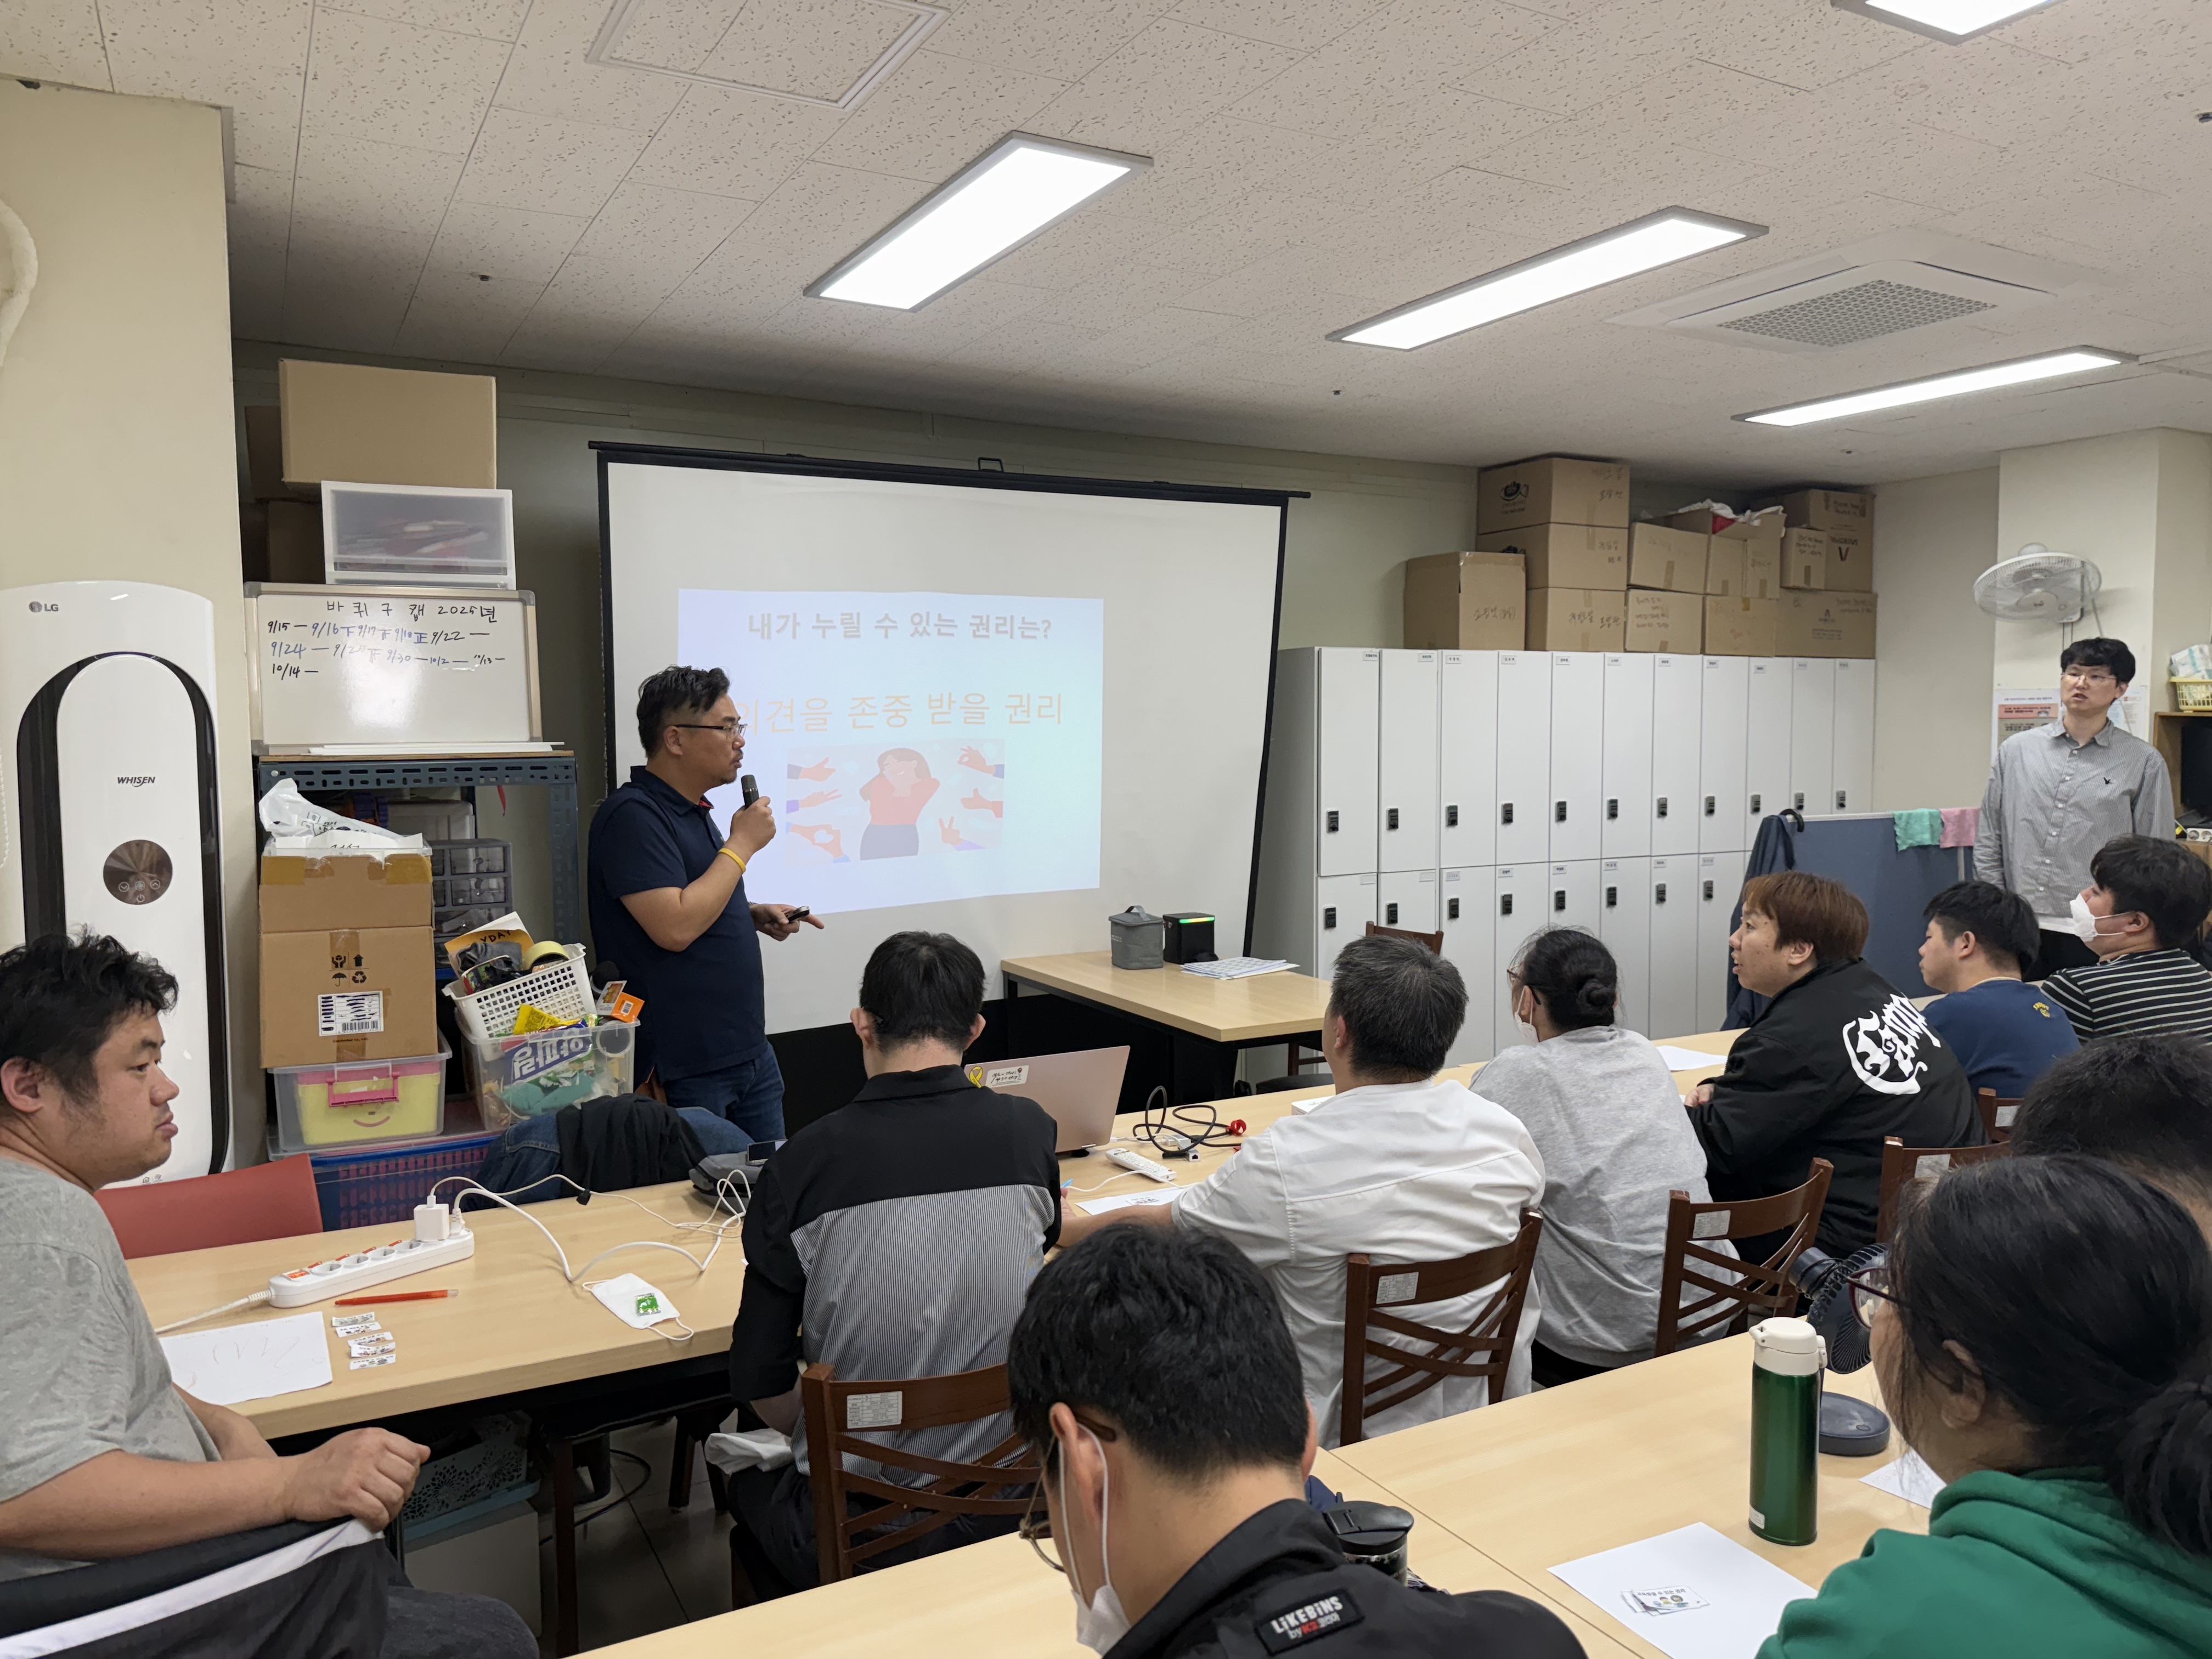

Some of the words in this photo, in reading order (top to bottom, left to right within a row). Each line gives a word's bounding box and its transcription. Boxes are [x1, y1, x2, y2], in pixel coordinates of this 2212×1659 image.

[44, 603, 59, 612] LG
[747, 613, 801, 642] 내가
[811, 611, 862, 640] 누릴
[874, 612, 899, 640] 수
[909, 611, 958, 638] 있는
[968, 614, 1052, 641] 권리는?
[431, 630, 466, 646] 9/22
[273, 663, 301, 681] 10/14
[848, 694, 913, 730] 존중
[928, 692, 990, 726] 받을
[1005, 692, 1063, 726] 권리
[117, 776, 156, 787] WHISEN
[512, 1028, 584, 1080] 양파링
